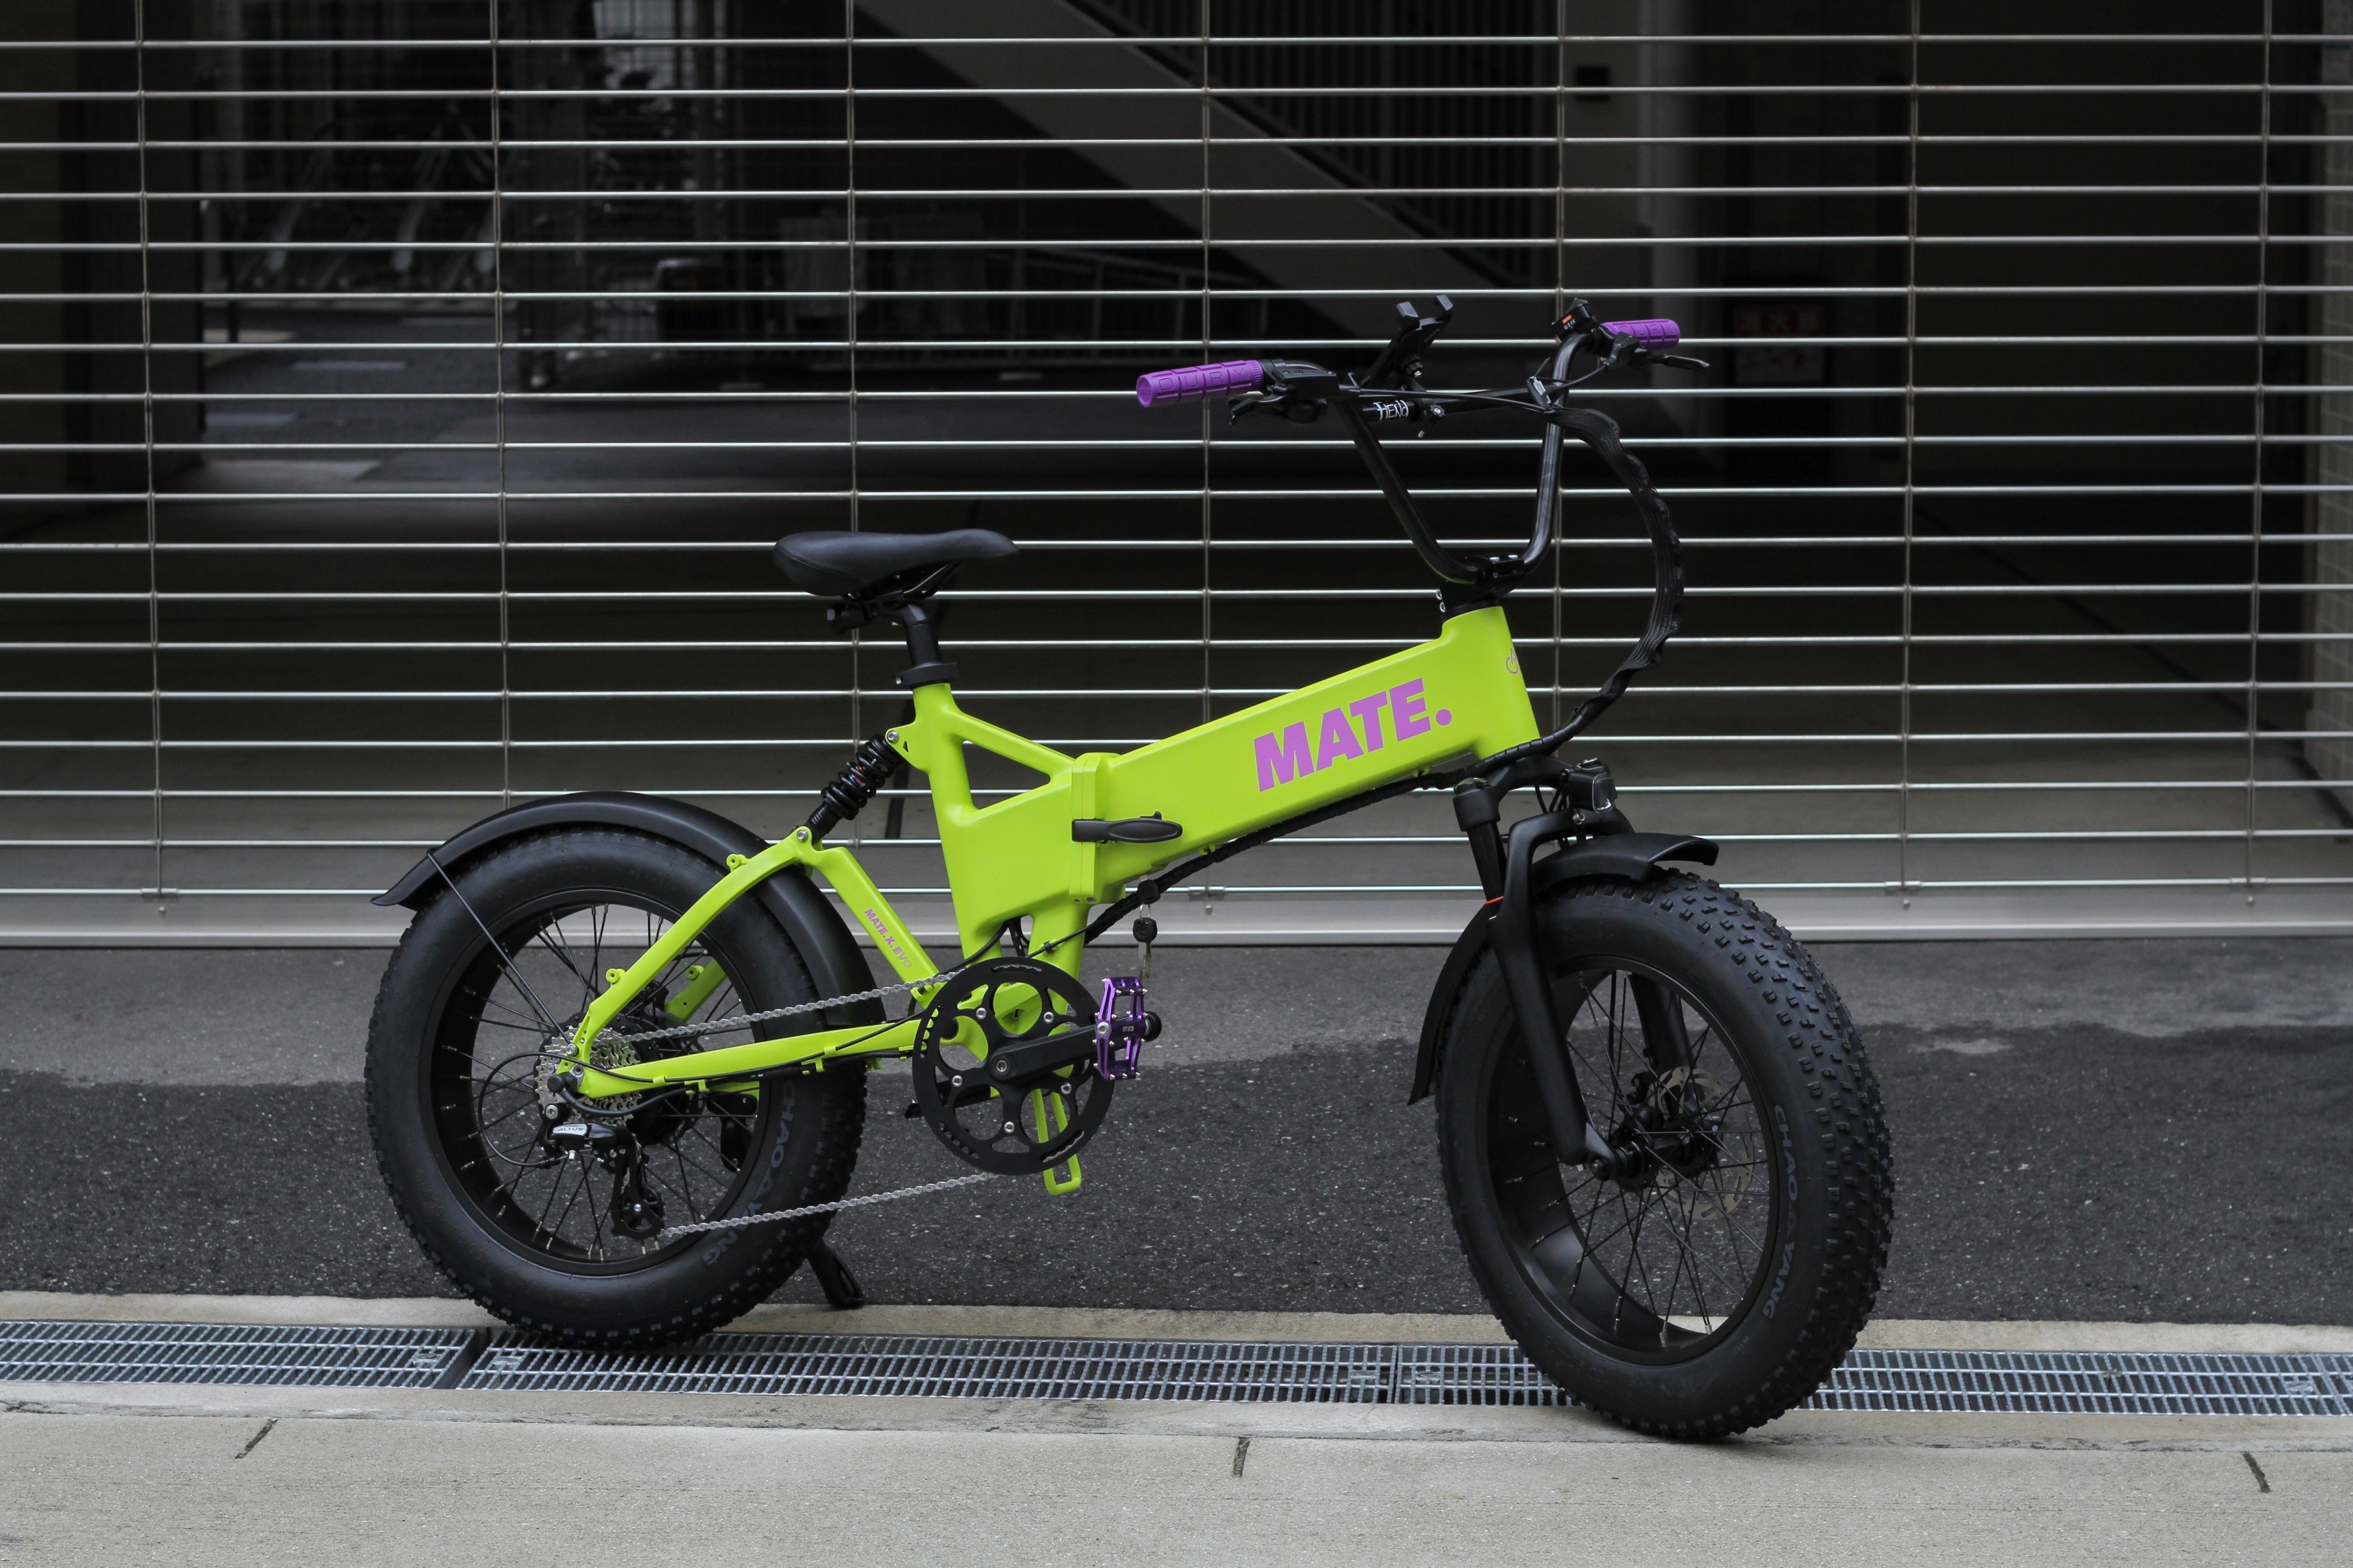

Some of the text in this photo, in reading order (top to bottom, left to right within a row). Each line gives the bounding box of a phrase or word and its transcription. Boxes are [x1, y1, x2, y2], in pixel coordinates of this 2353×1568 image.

[1158, 367, 1245, 391] OURY
[1253, 677, 1452, 792] MATE.
[771, 1079, 795, 1168] CHAO
[1762, 1105, 1798, 1319] CHAO YANG
